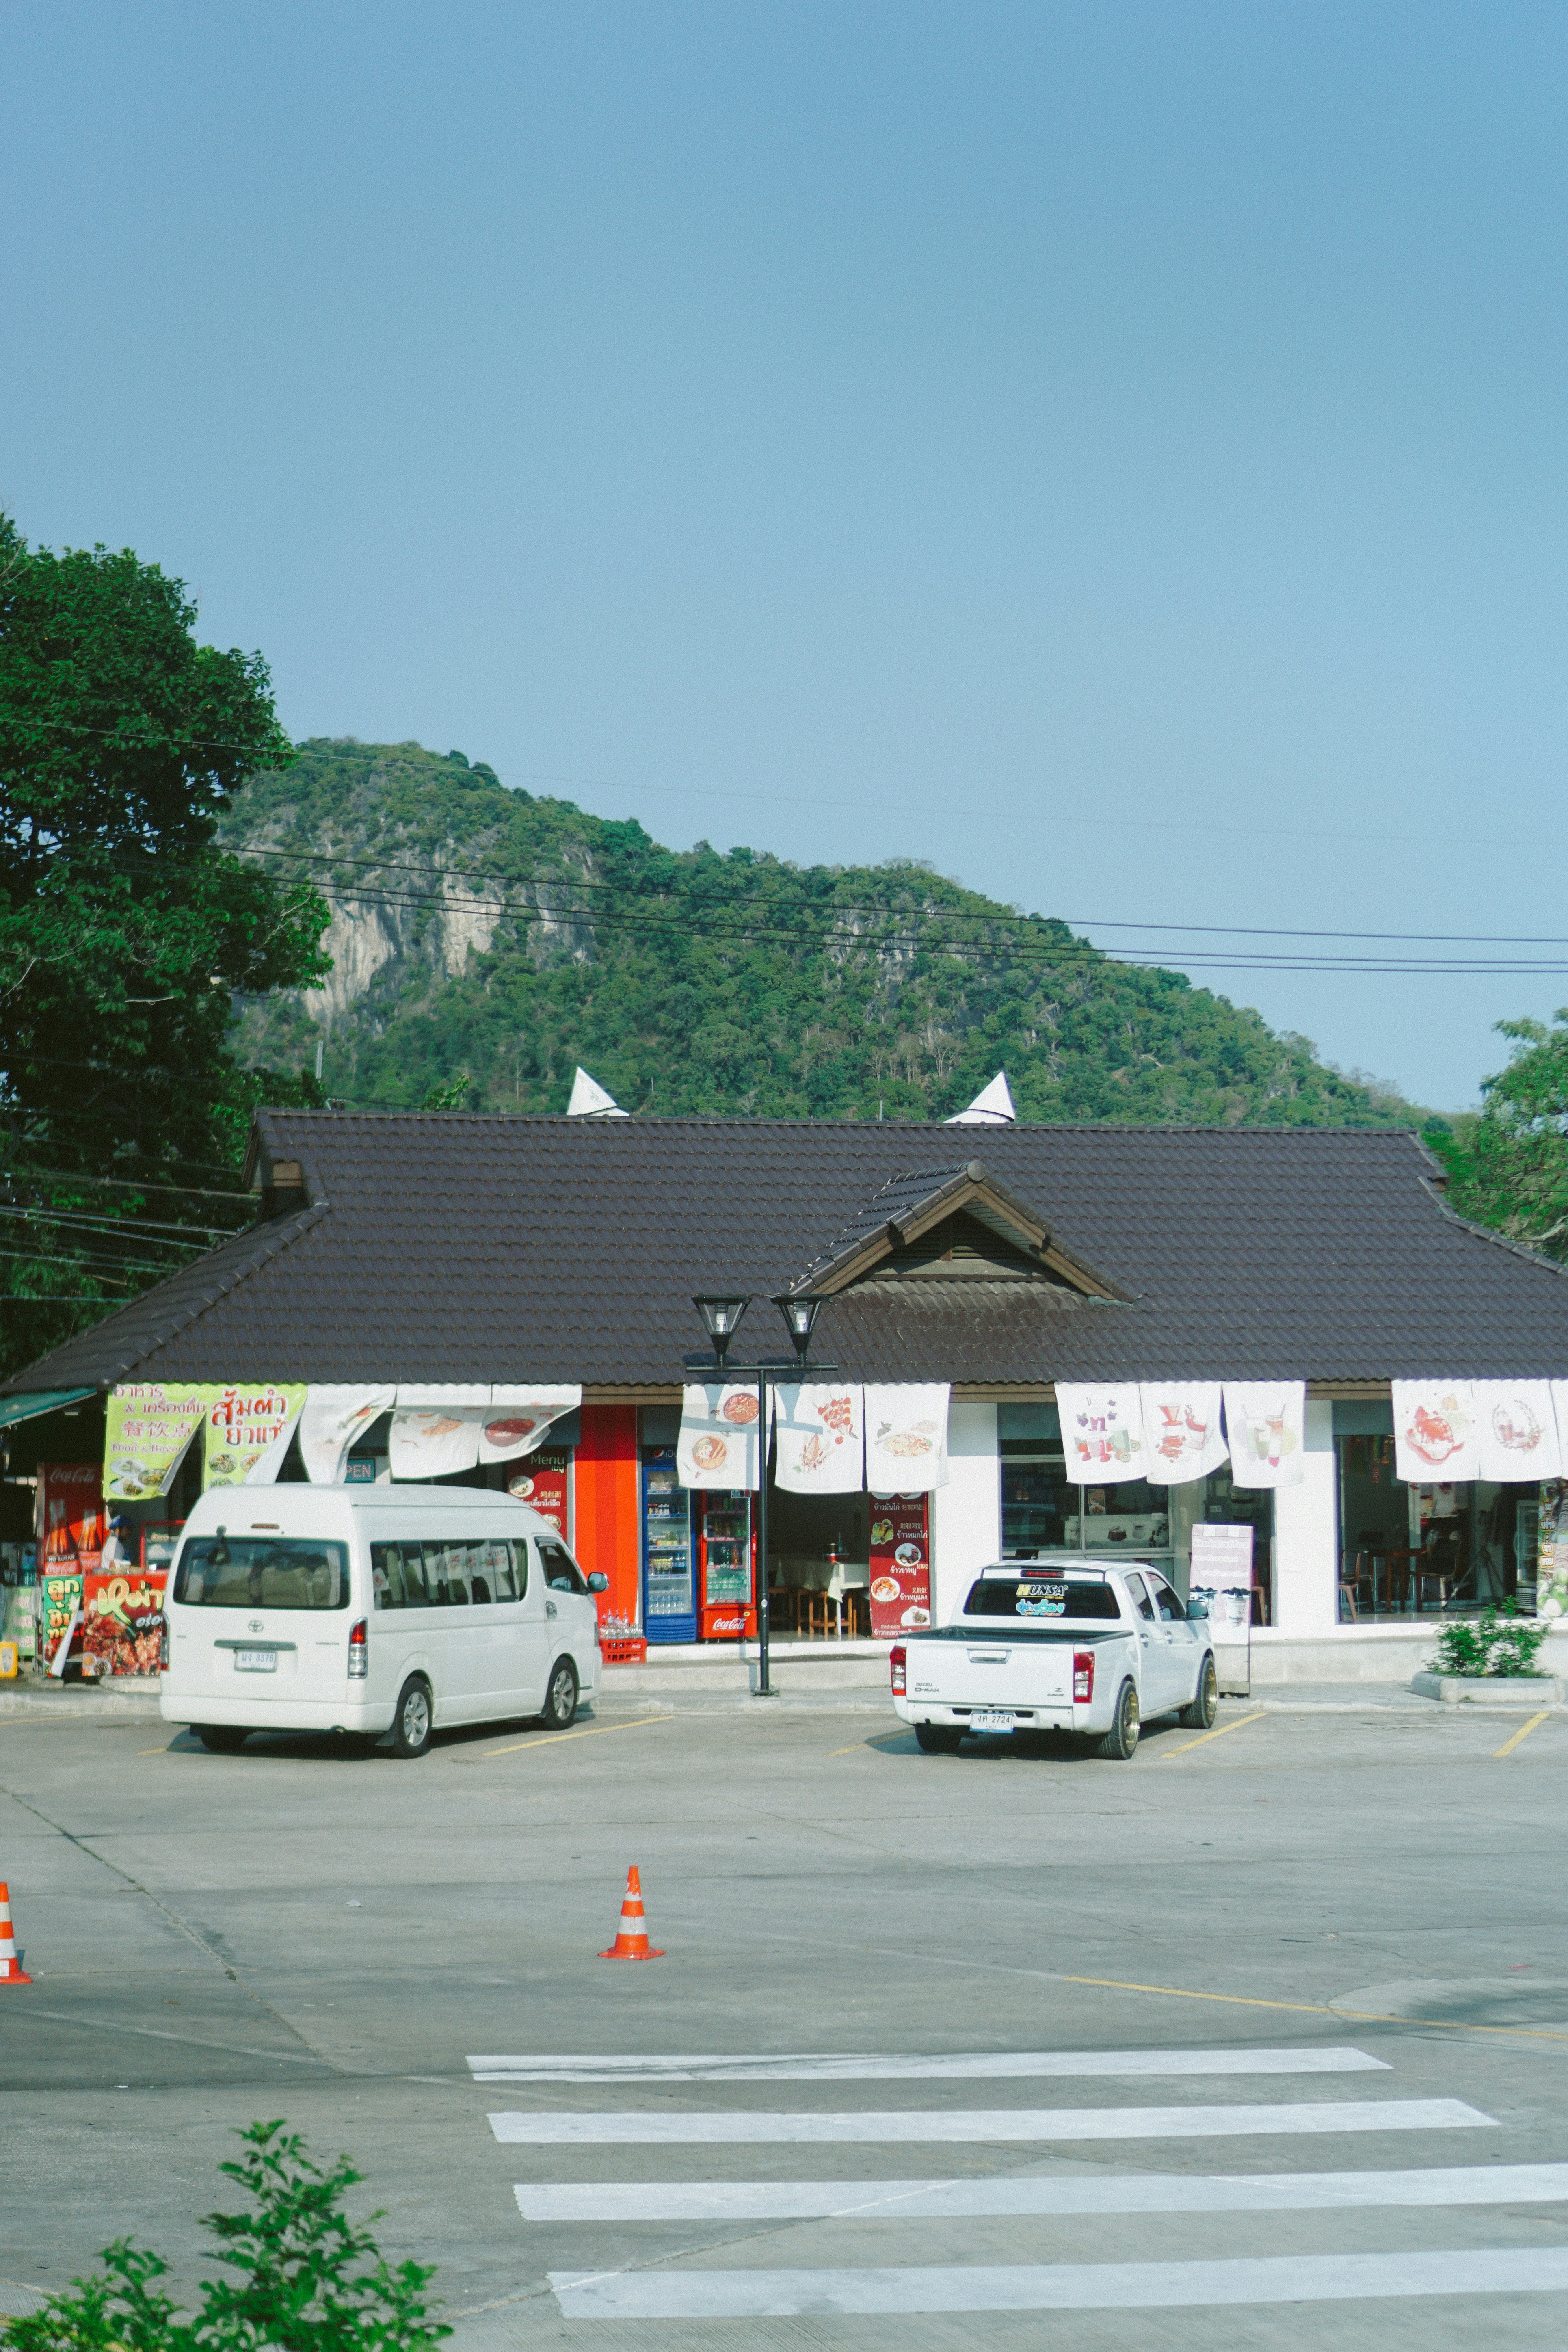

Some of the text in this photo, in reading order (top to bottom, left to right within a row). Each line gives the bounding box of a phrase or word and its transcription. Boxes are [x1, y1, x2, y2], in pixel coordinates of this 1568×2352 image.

[114, 1385, 163, 1398] อาหาร
[212, 1389, 287, 1425] ส้มตำ
[112, 1442, 138, 1452] Food
[531, 1454, 564, 1465] Menu
[874, 1502, 900, 1511] ข้าวมันไก่
[896, 1530, 928, 1538] ข้าวหมกไก่
[890, 1565, 917, 1576] ข้าวขาหมู
[47, 1579, 80, 1601] ลูก
[1016, 1584, 1064, 1596] HUNSA
[900, 1593, 928, 1602] ข้าวหมูแดง
[136, 1612, 163, 1627] อร่อ
